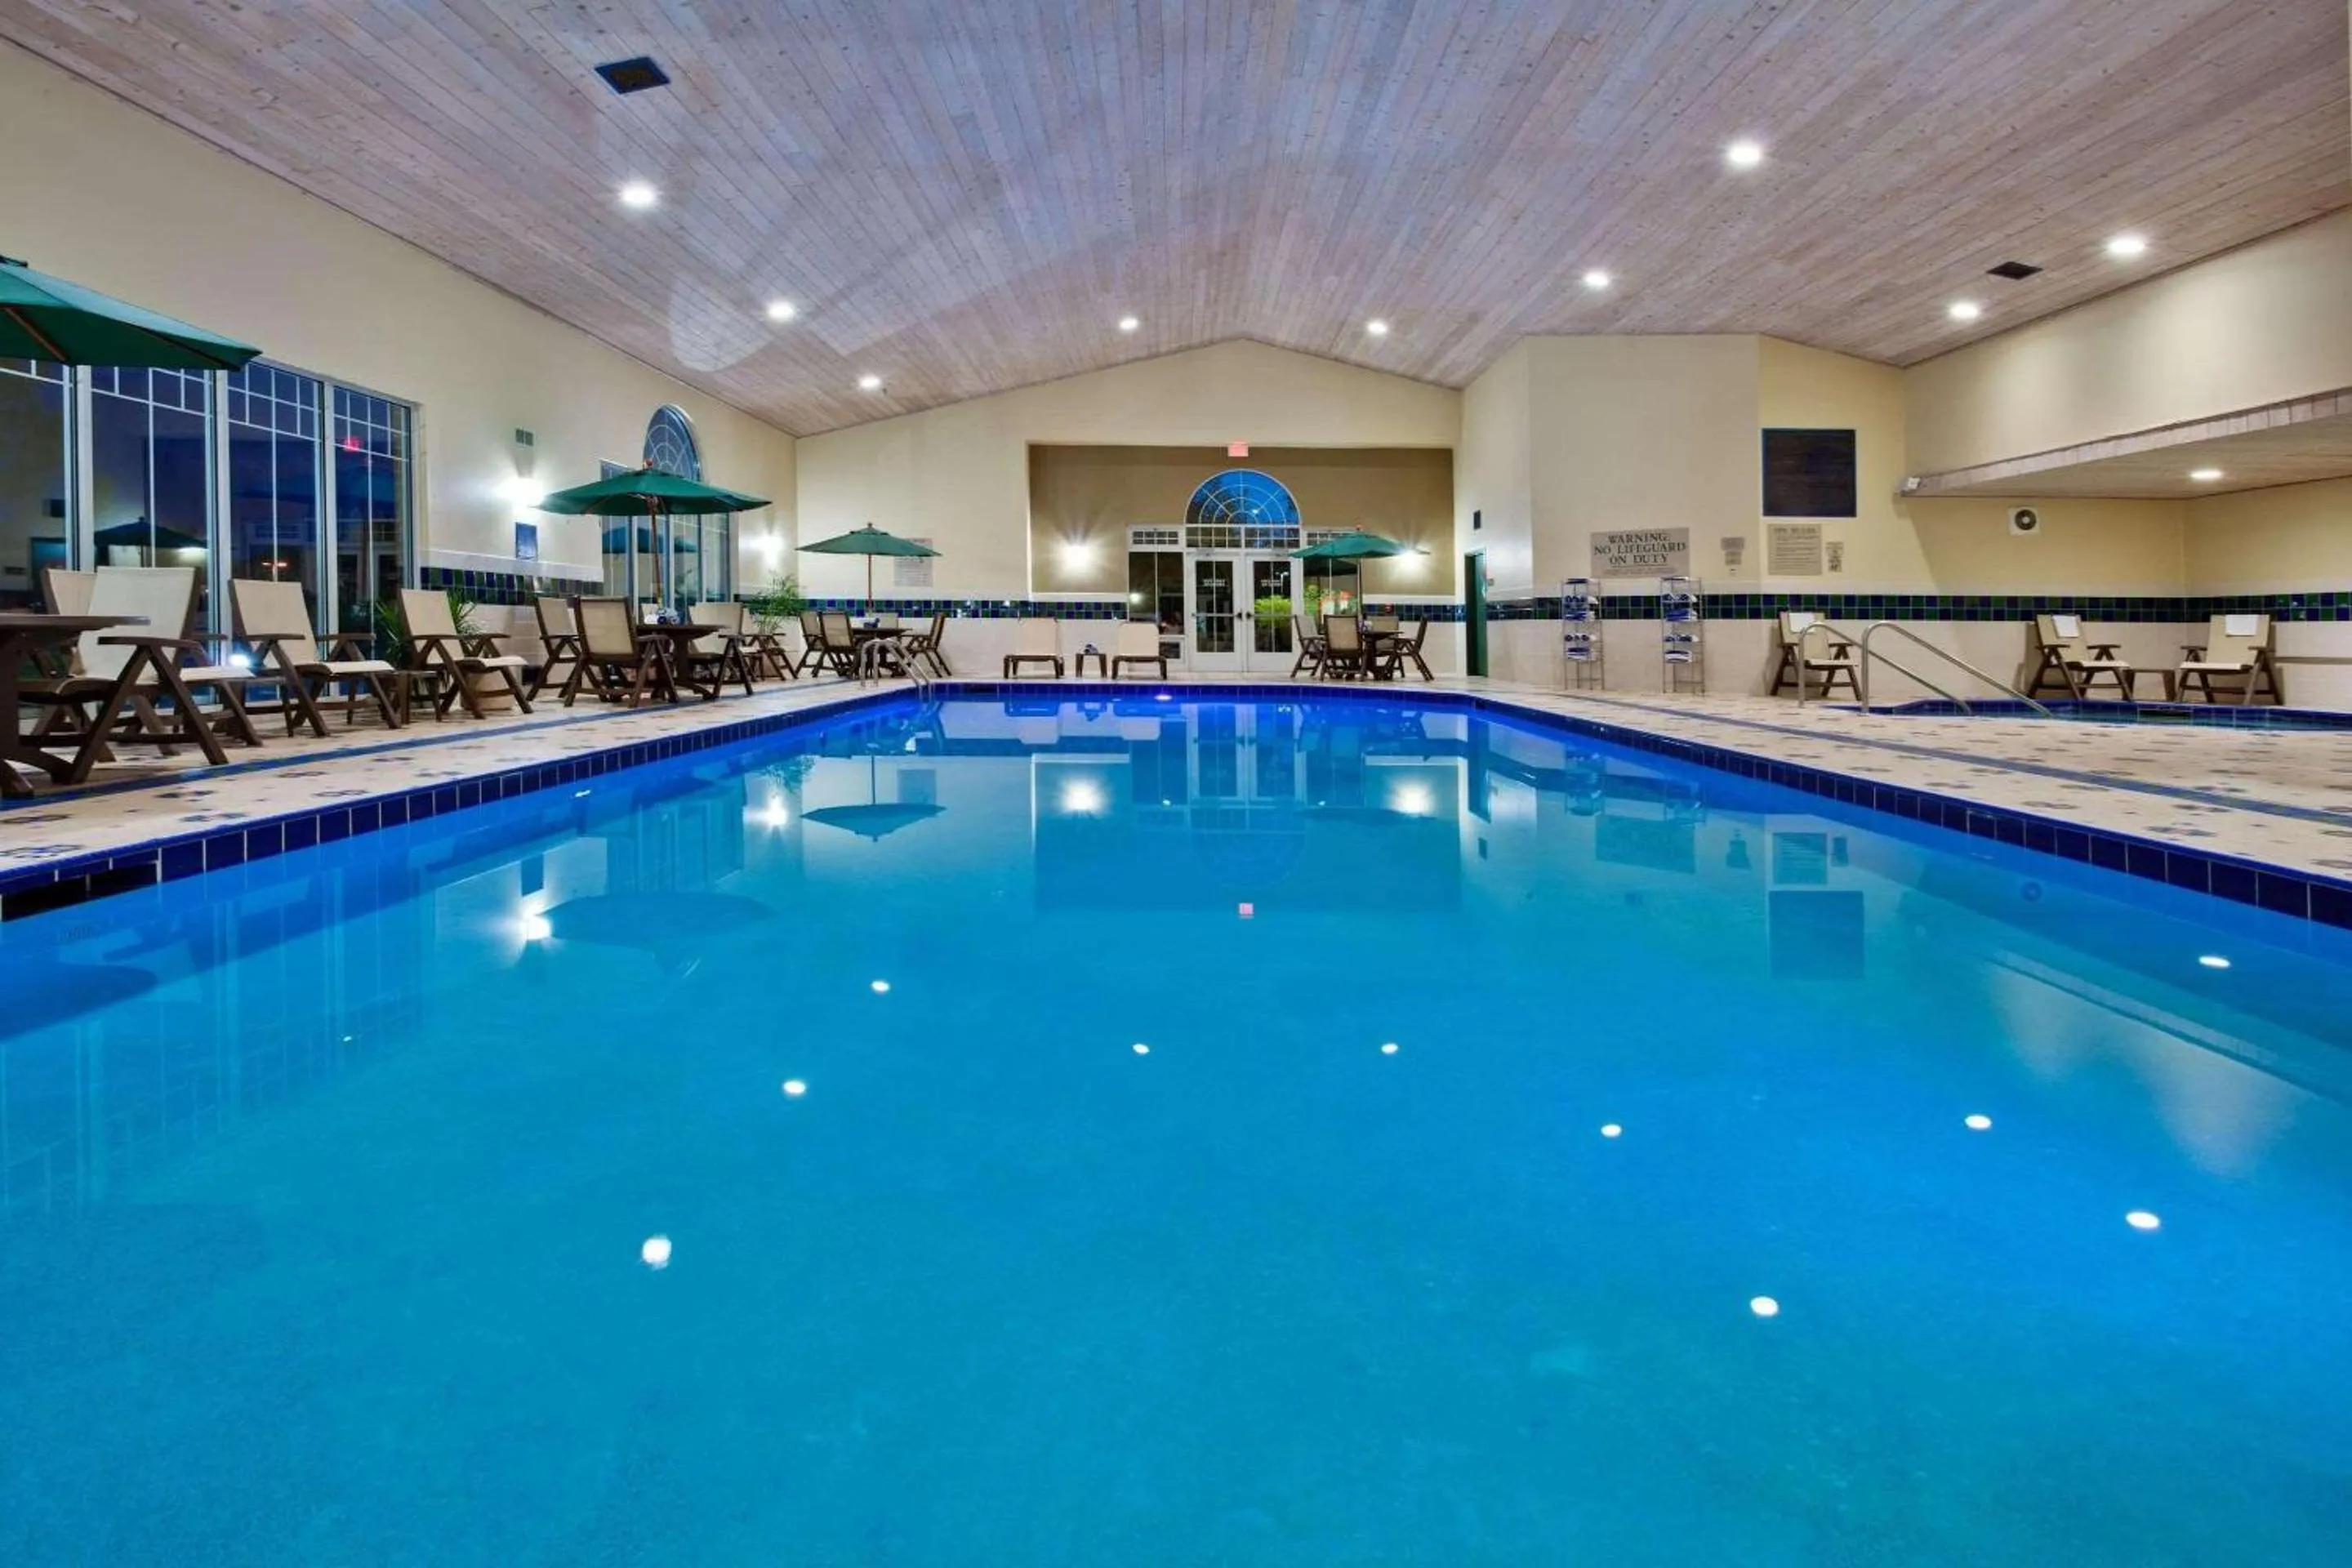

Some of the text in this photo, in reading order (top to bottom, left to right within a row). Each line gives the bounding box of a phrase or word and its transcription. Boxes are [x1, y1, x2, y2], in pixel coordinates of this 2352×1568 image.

[1594, 542, 1686, 555] NO LIFEGUARD
[1609, 554, 1668, 565] ON DUTY
